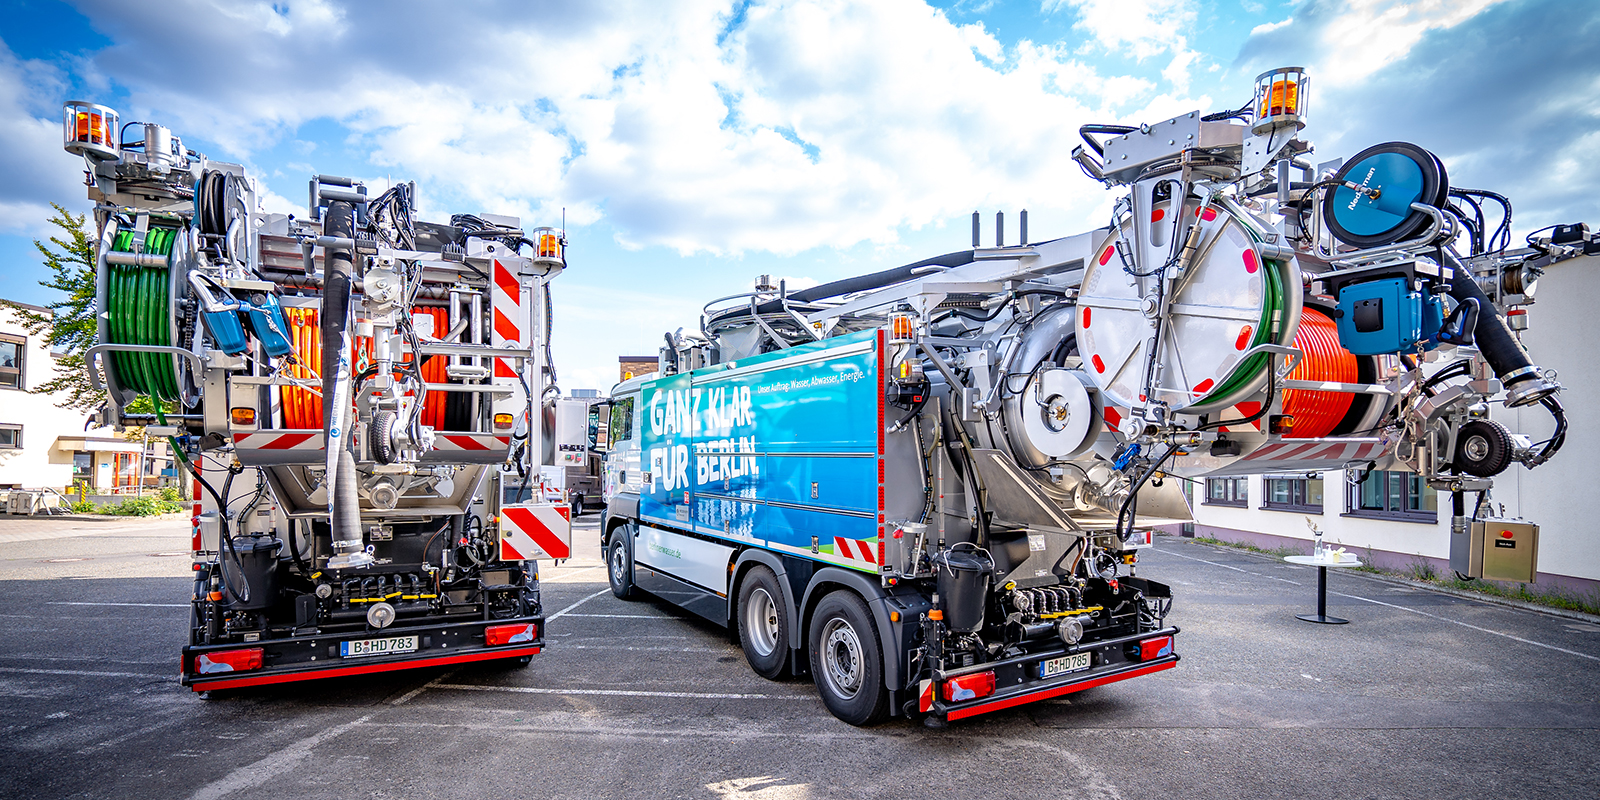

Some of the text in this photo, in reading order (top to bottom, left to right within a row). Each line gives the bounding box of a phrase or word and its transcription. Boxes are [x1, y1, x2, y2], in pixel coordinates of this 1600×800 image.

[1347, 167, 1376, 211] Nedman
[757, 369, 866, 394] Unser Auftrag: Wasser, Abwasser, Energie.
[650, 385, 752, 436] GANZ KLAR
[650, 434, 760, 494] FÜR BERLIN.
[354, 638, 413, 653] B HD 783
[1048, 660, 1054, 673] B
[1059, 658, 1071, 670] HD
[1072, 654, 1087, 667] 785
